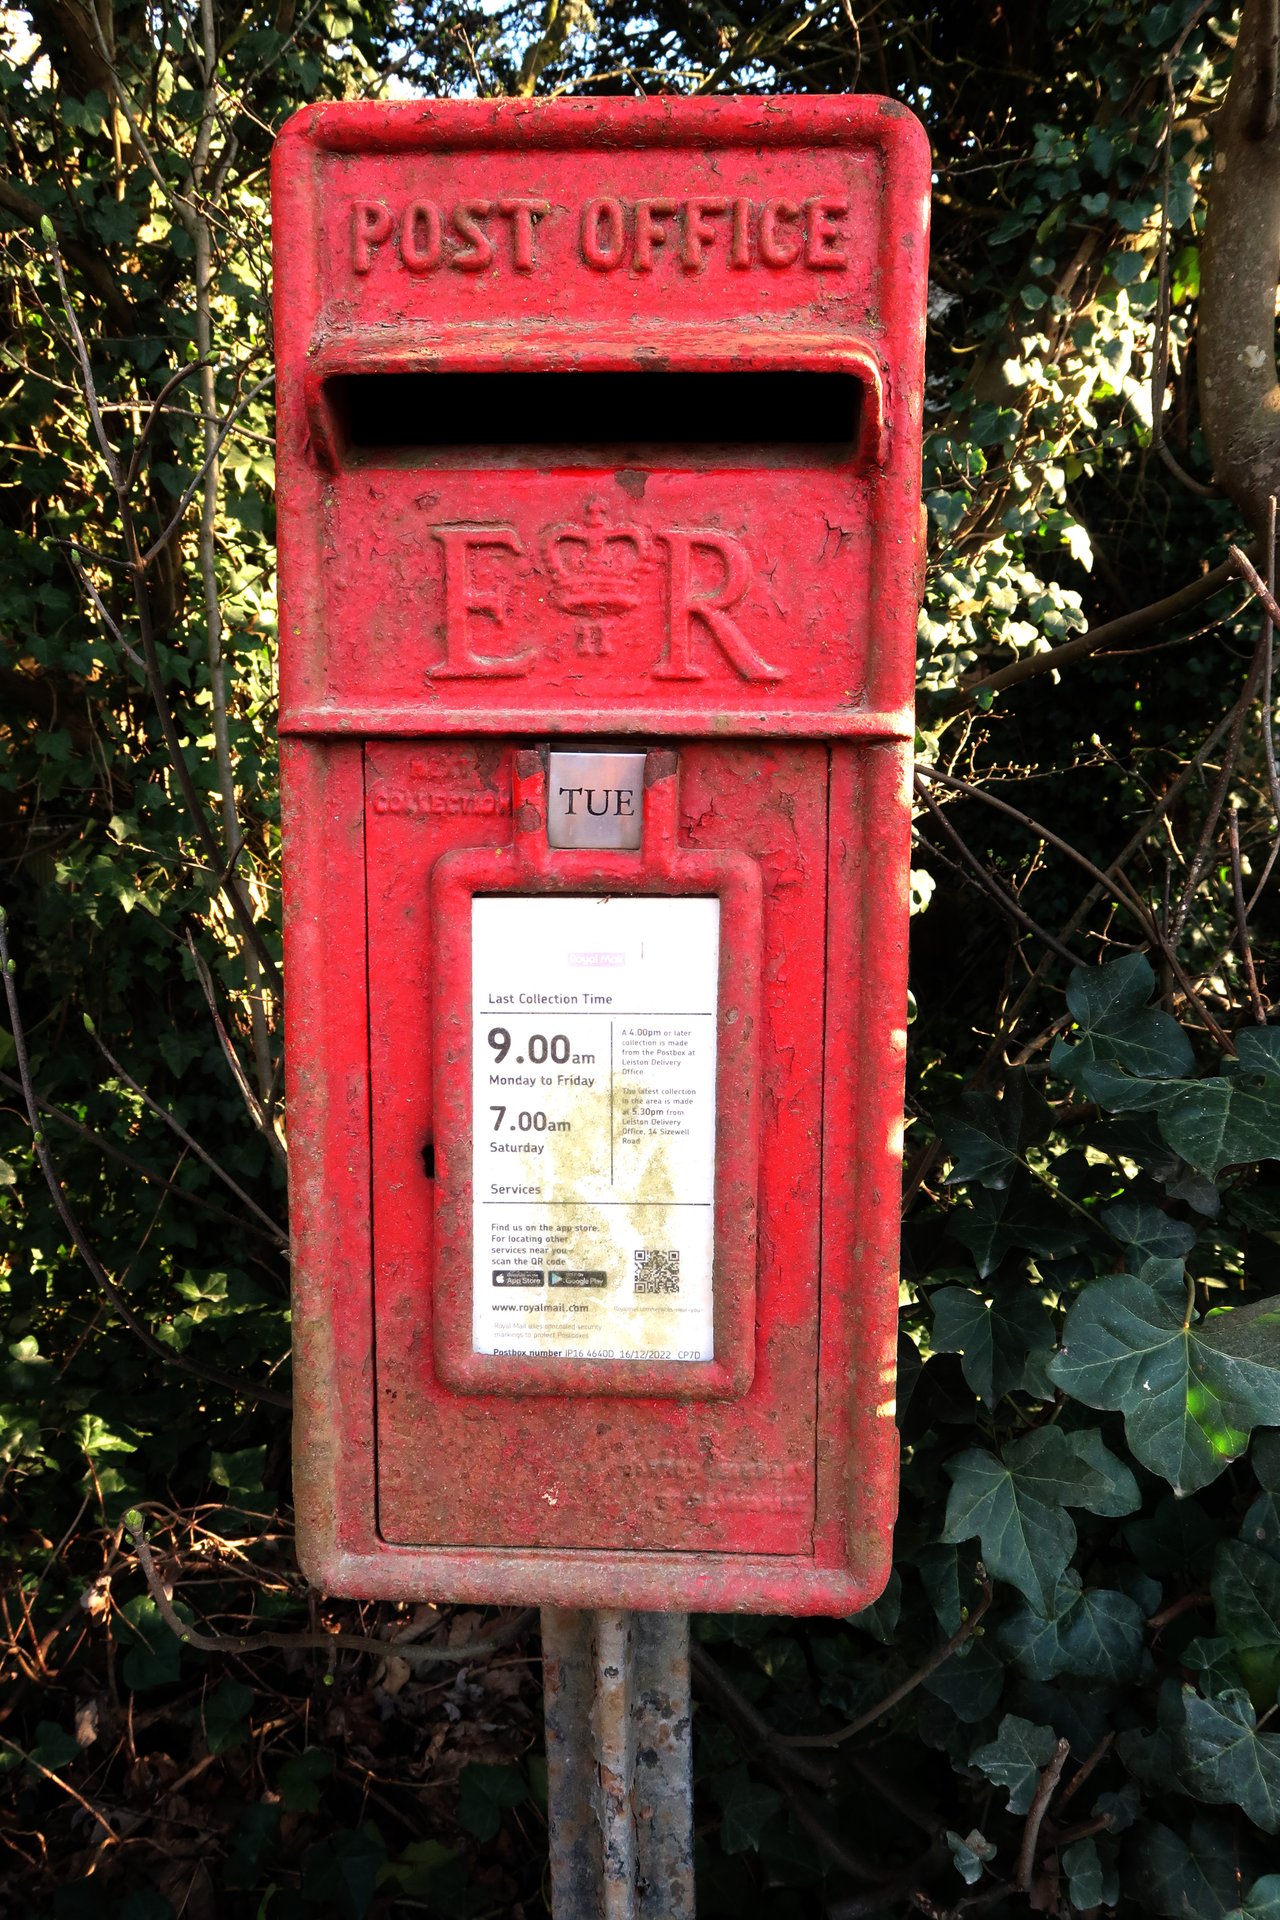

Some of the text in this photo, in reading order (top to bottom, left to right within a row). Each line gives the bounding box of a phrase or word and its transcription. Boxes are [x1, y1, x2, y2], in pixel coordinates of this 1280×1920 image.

[351, 198, 849, 275] POST OFFICE
[426, 520, 788, 682] E R
[559, 787, 635, 816] TUE
[488, 993, 613, 1004] Last Collection Time
[629, 1029, 661, 1037] 4.00pm
[487, 1027, 595, 1064] 9.00am
[651, 1059, 681, 1067] Delivery
[489, 1075, 595, 1087] Monday to Friday
[632, 1108, 664, 1117] 5.30pm
[490, 1106, 571, 1132] 7.00am
[490, 1142, 544, 1154] Saturday
[491, 1184, 541, 1195] Services
[557, 1225, 572, 1233] app
[509, 1235, 542, 1244] locating
[491, 1246, 526, 1254] services
[552, 1248, 567, 1256] you
[492, 1304, 589, 1313] www.royalmail.com
[493, 1349, 527, 1357] Postbox
[529, 1349, 562, 1357] number
[620, 1350, 671, 1359] 16/12/2022
[678, 1351, 701, 1359] CP7D
